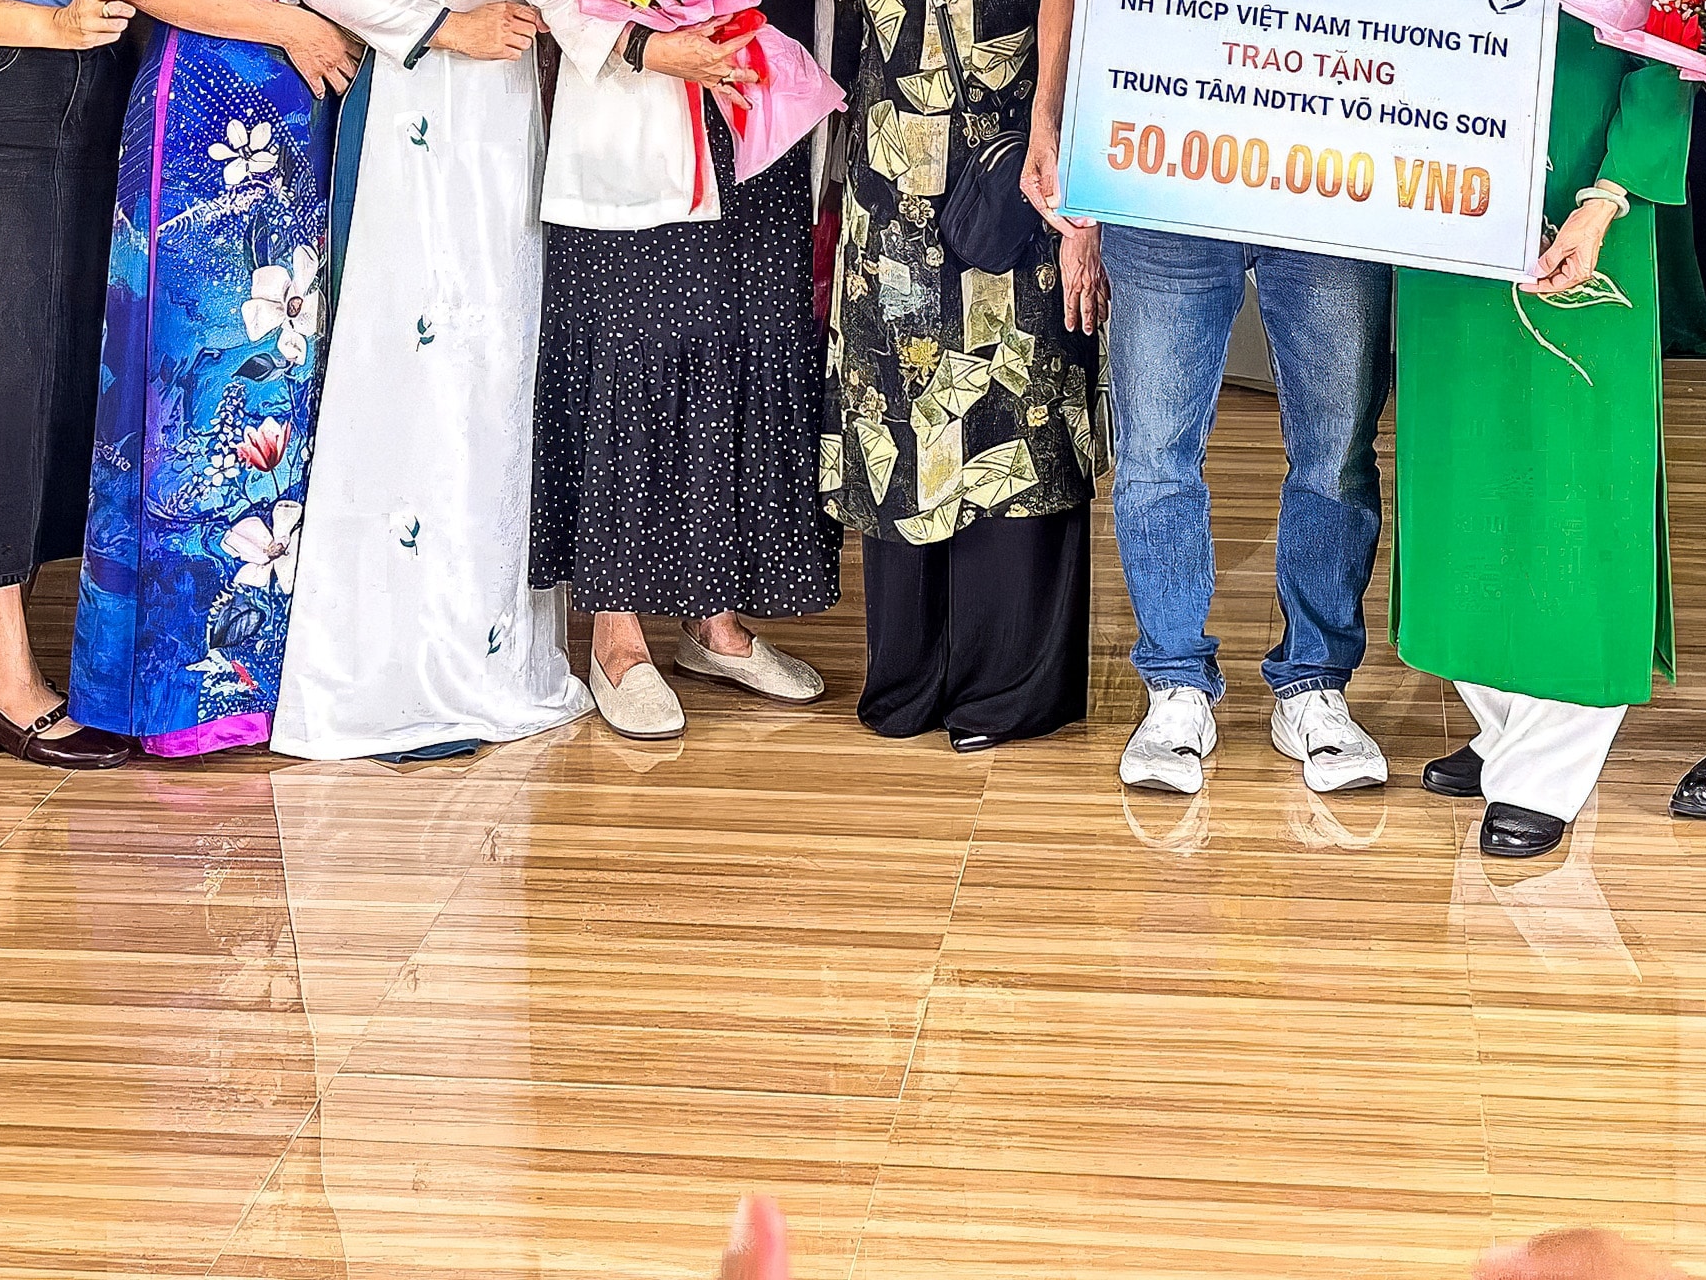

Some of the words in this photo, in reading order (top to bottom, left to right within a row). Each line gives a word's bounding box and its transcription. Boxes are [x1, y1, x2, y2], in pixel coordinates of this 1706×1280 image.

[1237, 4, 1289, 31] VIỆT
[1295, 12, 1351, 37] NAM
[1358, 20, 1461, 51] THƯƠNG
[1468, 31, 1508, 58] TÍN
[1222, 41, 1303, 73] TRAO
[1313, 49, 1395, 86] TẶNG
[1108, 68, 1188, 97] TRUNG
[1195, 78, 1246, 105] TÂM
[1253, 87, 1334, 116] NDTKT
[1341, 96, 1373, 121] VÕ
[1379, 99, 1448, 131] HỒNG
[1455, 114, 1507, 139] SƠN
[1106, 119, 1375, 203] 50.000.000
[1393, 155, 1491, 218] VNĐ
